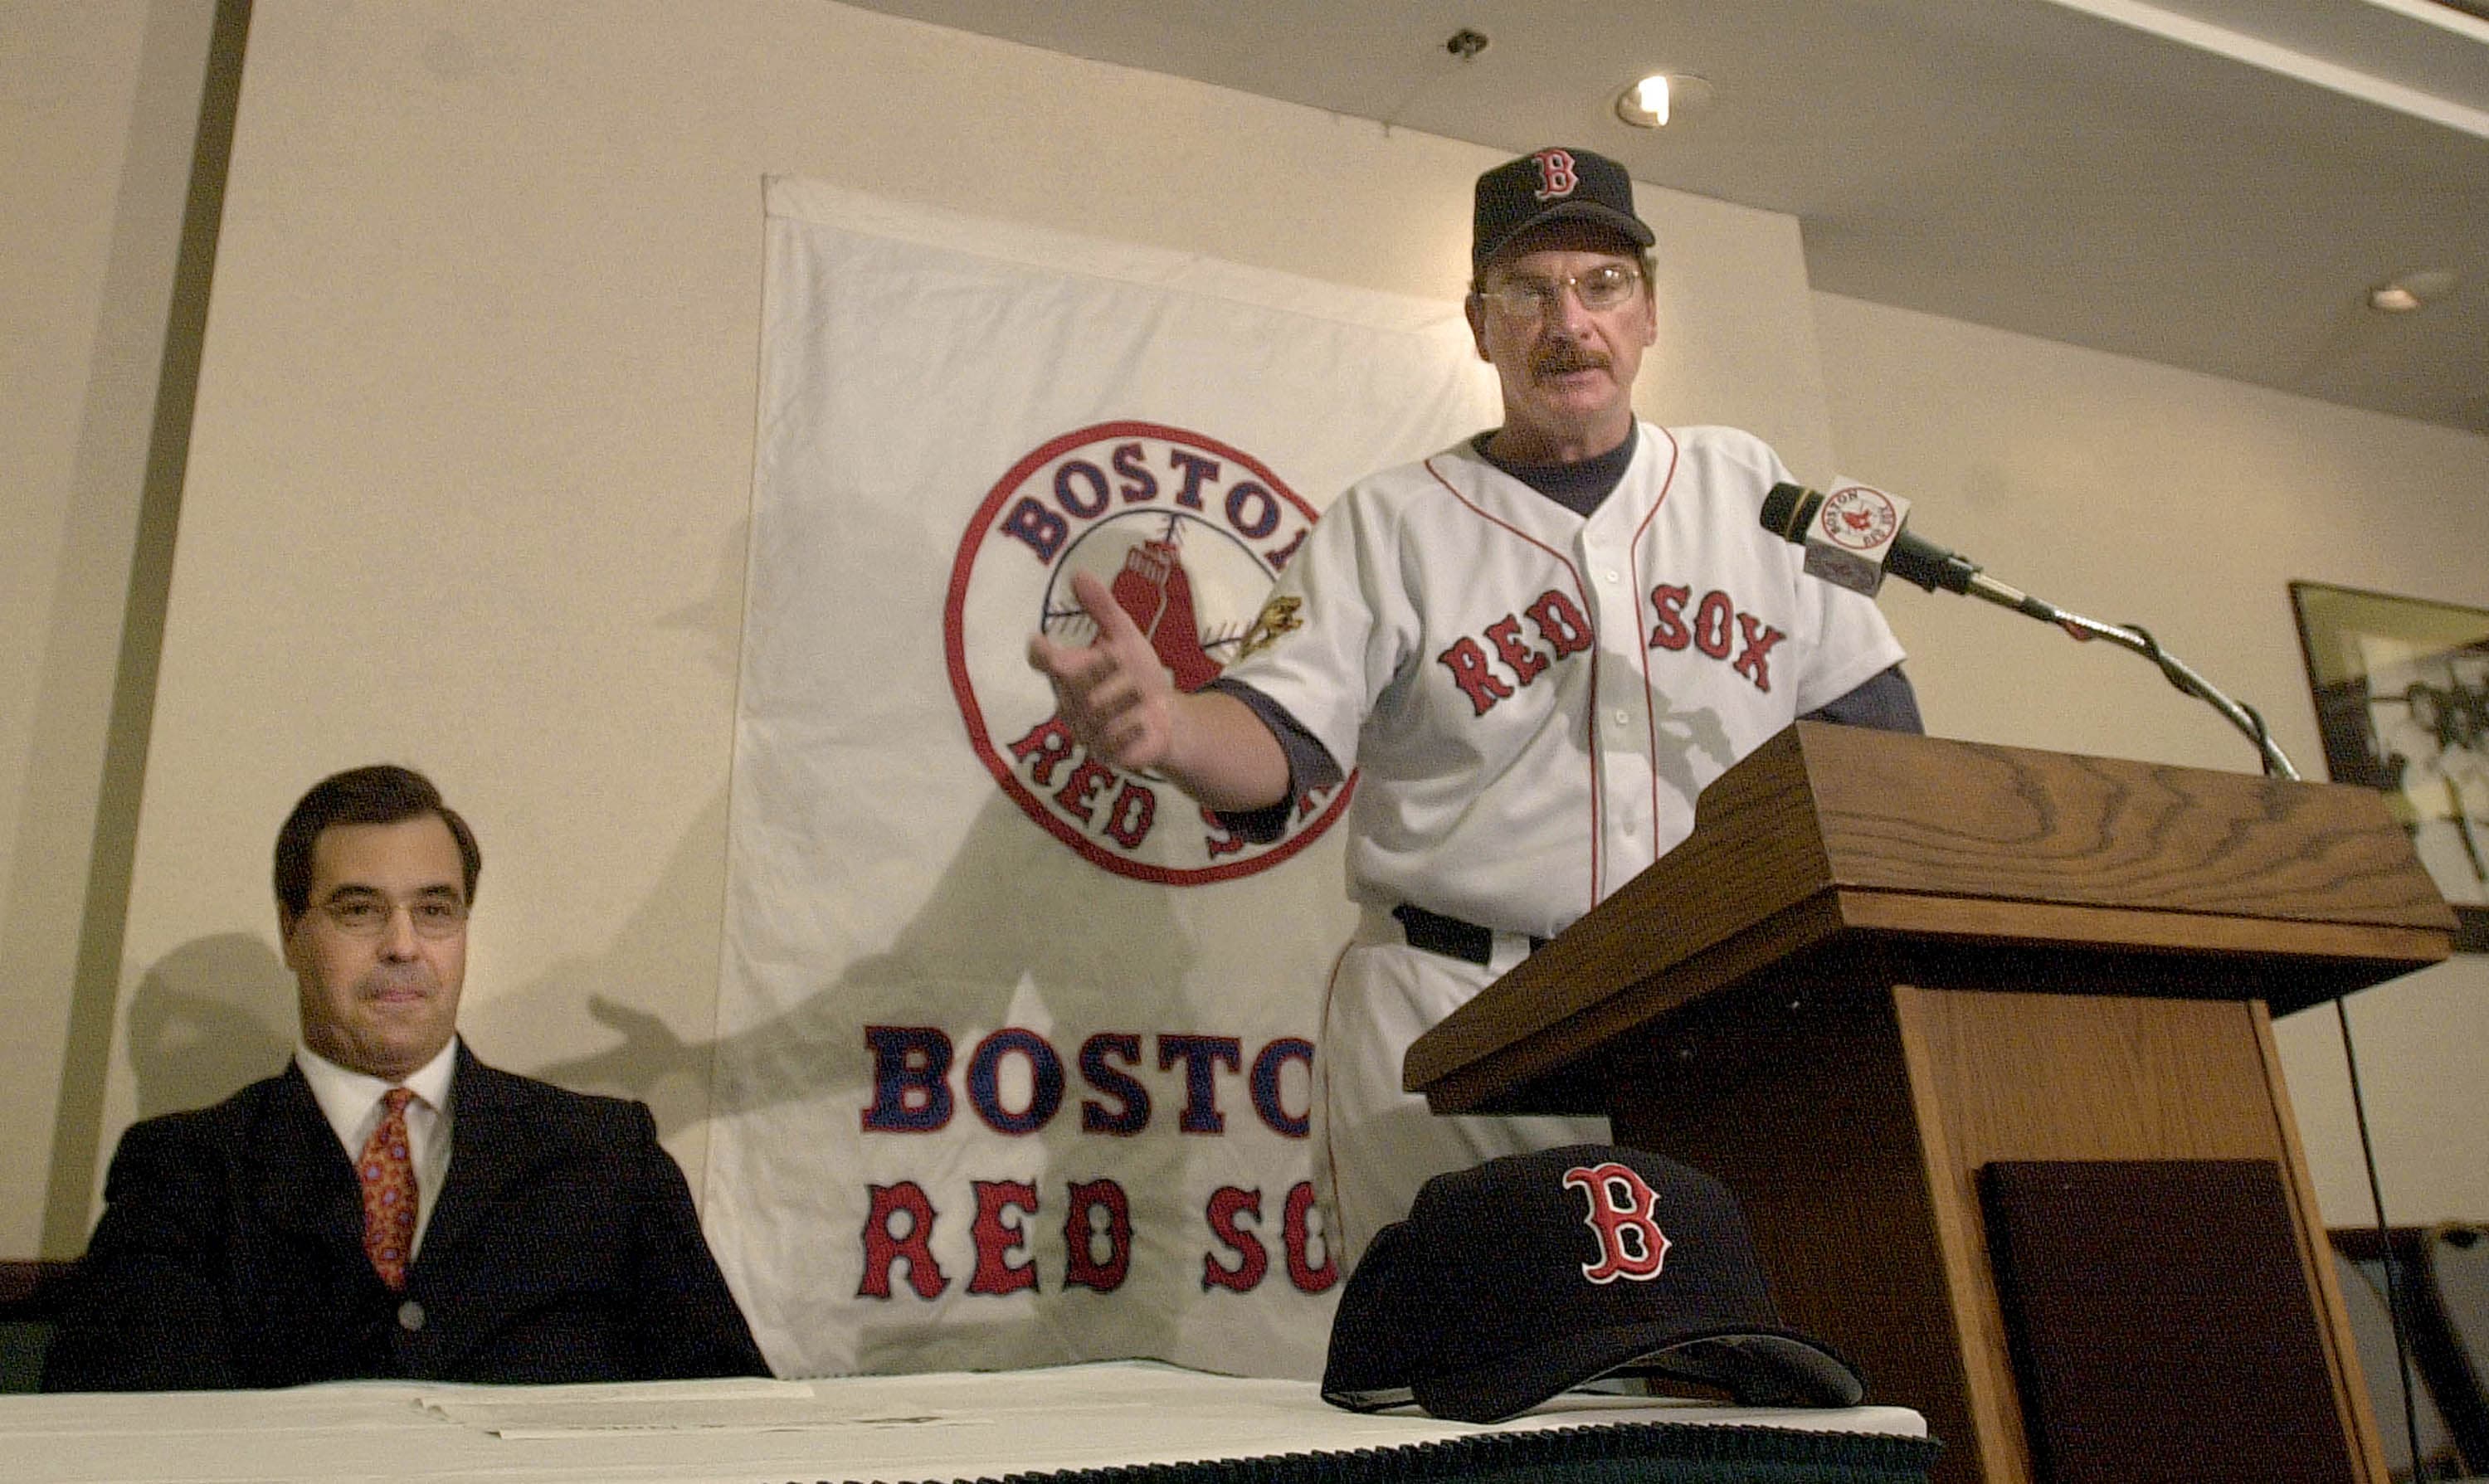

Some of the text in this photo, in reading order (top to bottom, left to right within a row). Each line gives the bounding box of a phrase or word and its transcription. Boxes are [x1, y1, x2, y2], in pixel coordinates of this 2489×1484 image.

[1532, 147, 1578, 200] B
[1436, 583, 1787, 717] RED SOX
[1006, 717, 1157, 850] RED
[855, 1178, 1134, 1301] RED
[1562, 1162, 1673, 1283] B
